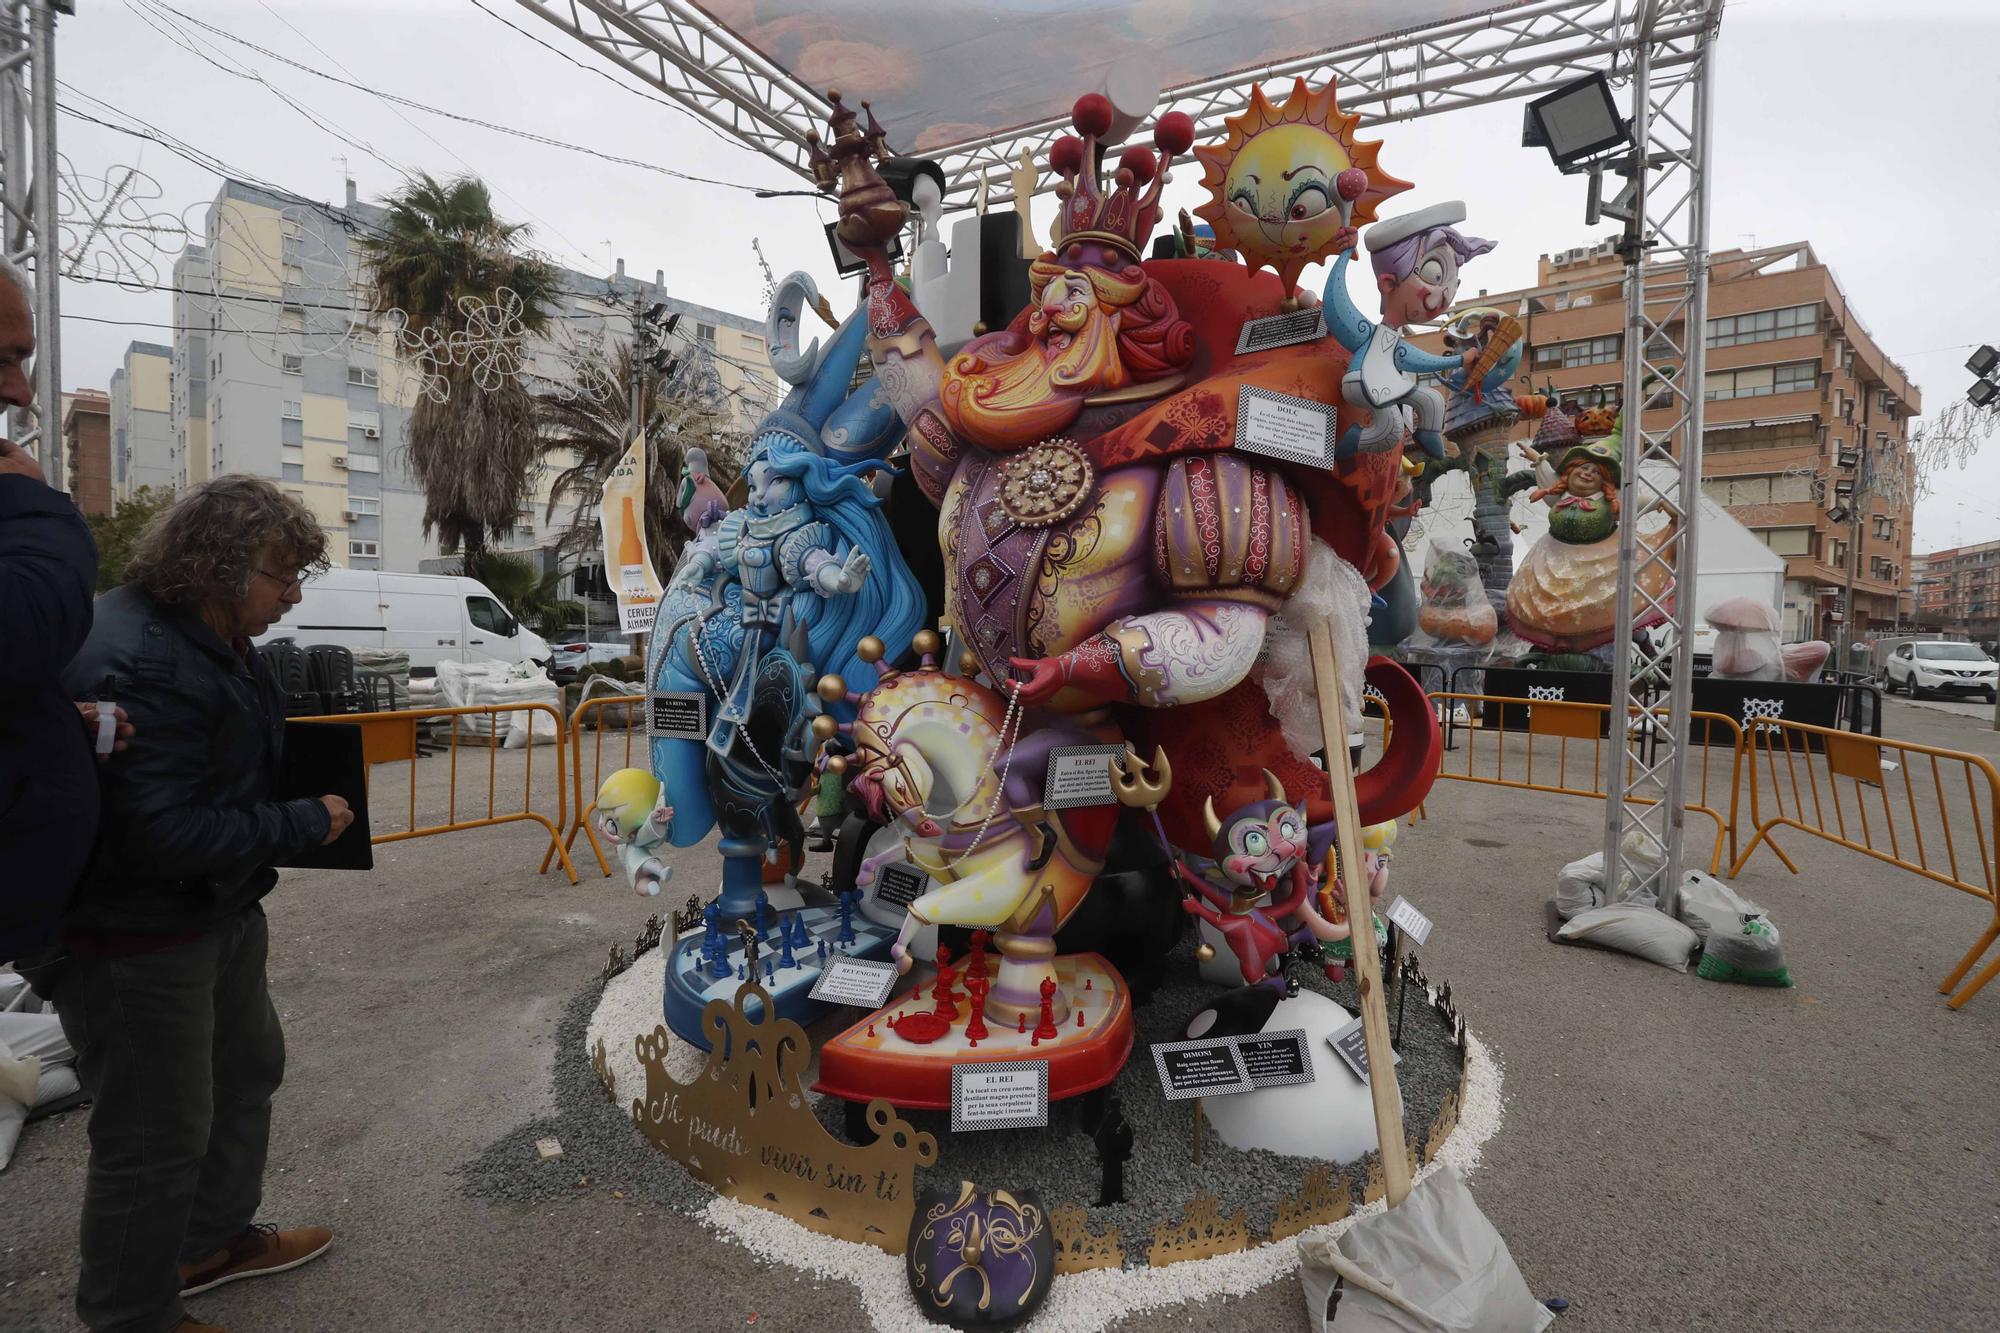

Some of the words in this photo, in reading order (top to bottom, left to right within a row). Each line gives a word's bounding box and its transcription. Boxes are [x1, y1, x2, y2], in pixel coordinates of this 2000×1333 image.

[627, 607, 657, 618] CERVEZA
[1182, 1050, 1212, 1059] DIMONI
[761, 1146, 818, 1181] vivir
[824, 1163, 868, 1193] sin
